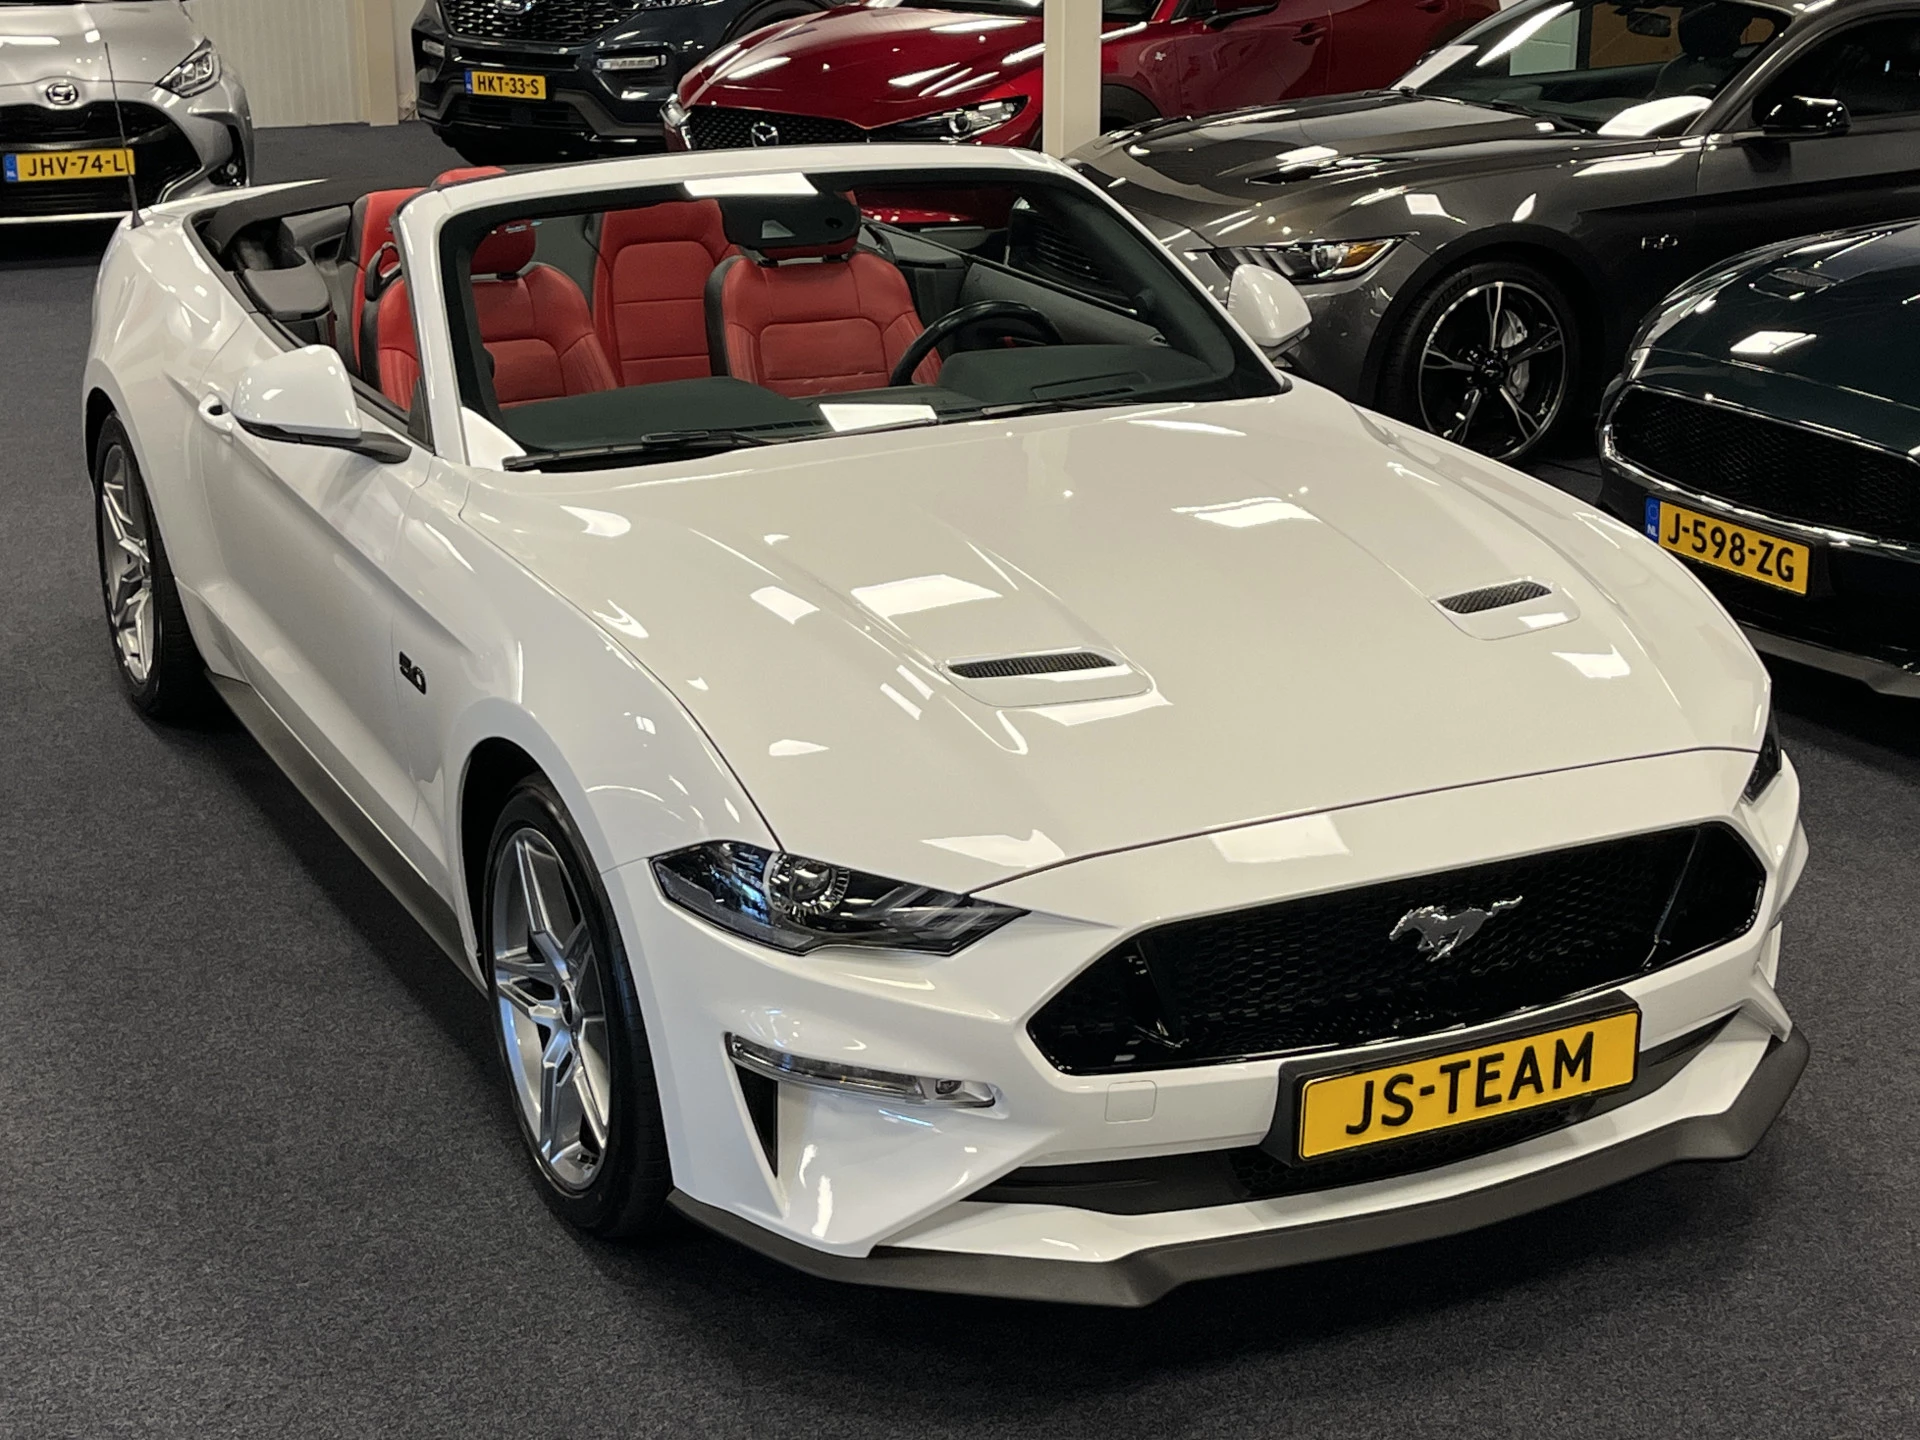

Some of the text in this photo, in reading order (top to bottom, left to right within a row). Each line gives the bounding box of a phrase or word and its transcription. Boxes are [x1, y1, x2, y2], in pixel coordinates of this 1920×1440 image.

[477, 75, 539, 95] HKT-33-S
[28, 154, 125, 176] JHV-74-L
[1667, 513, 1794, 582] J-598-ZG
[1346, 1031, 1594, 1135] JS-TEAM
